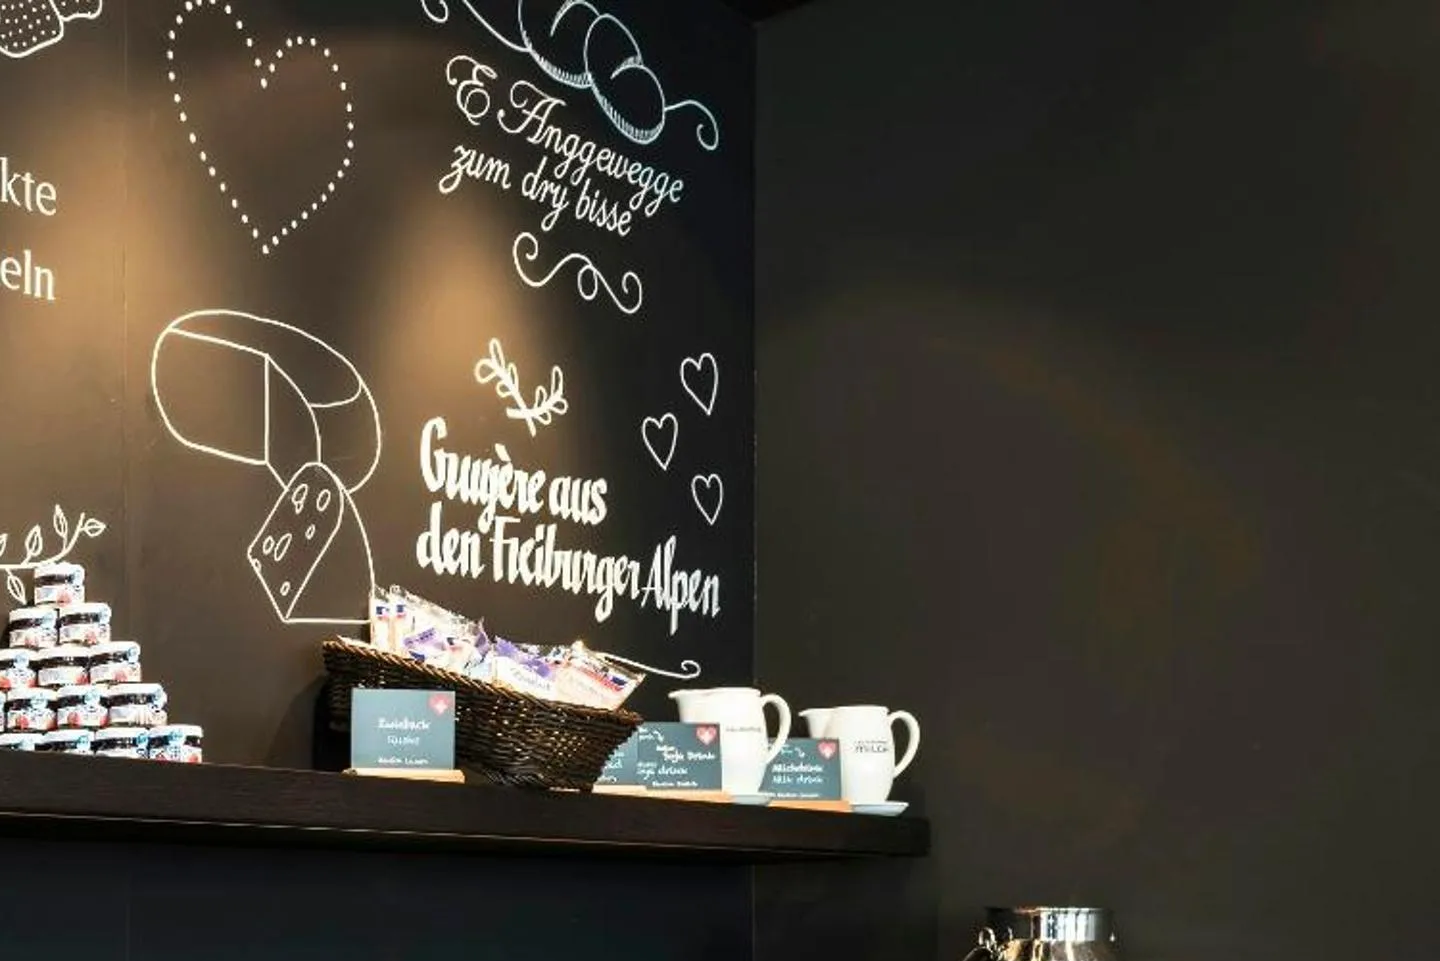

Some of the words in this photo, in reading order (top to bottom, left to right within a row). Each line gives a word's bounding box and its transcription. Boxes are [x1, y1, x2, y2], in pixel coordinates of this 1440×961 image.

[439, 145, 511, 194] zum
[521, 156, 569, 232] dry
[575, 178, 633, 236] bisse
[420, 416, 546, 534] Gruyère
[548, 475, 609, 526] aus
[416, 501, 486, 579] den
[640, 534, 721, 636] Alpen
